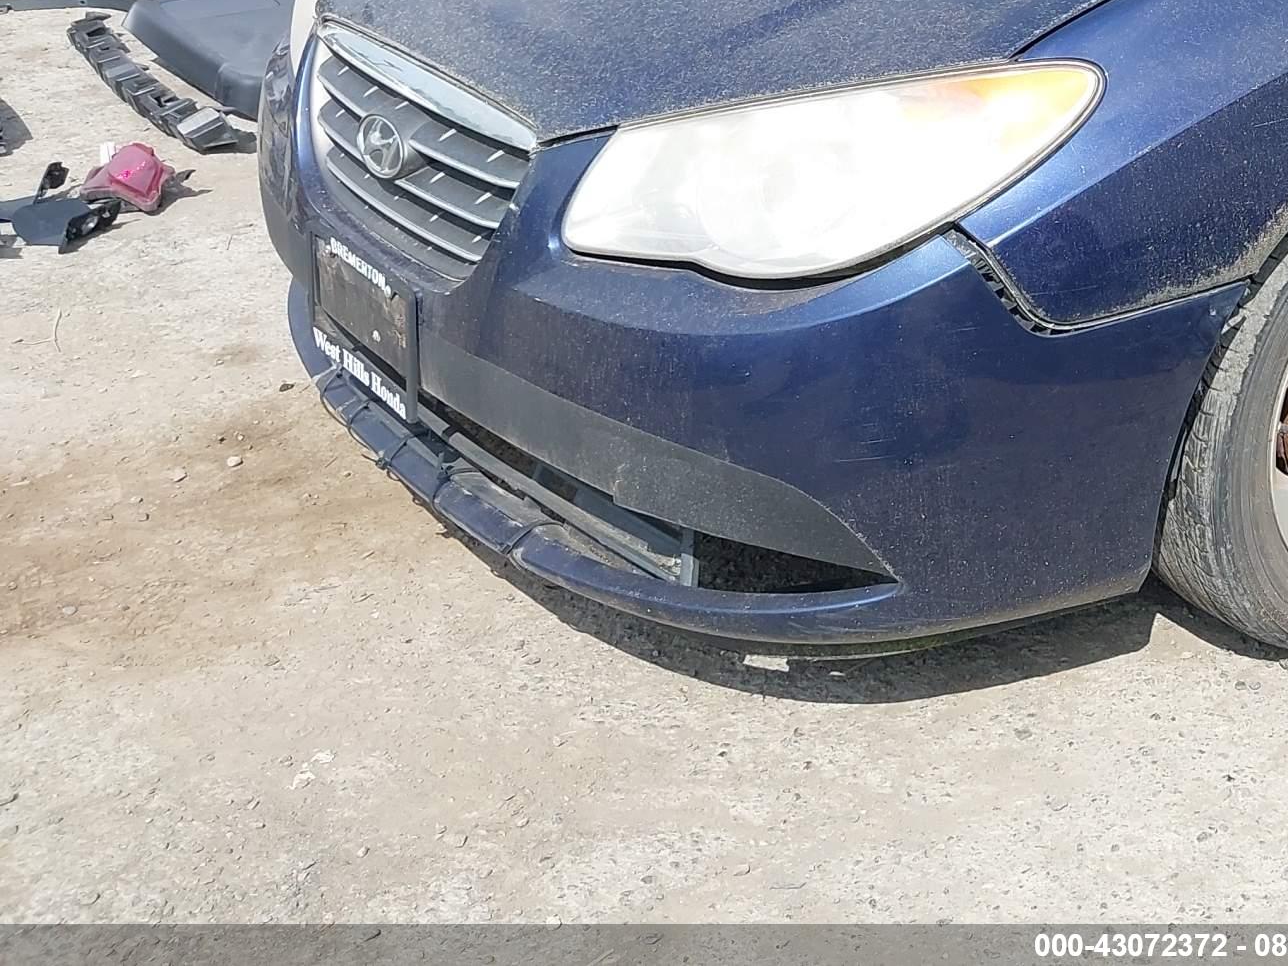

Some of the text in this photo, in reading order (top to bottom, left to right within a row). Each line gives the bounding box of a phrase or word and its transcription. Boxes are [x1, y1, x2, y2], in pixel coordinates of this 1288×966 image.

[331, 237, 386, 292] BREMERTON
[312, 326, 407, 420] West Hills Honda
